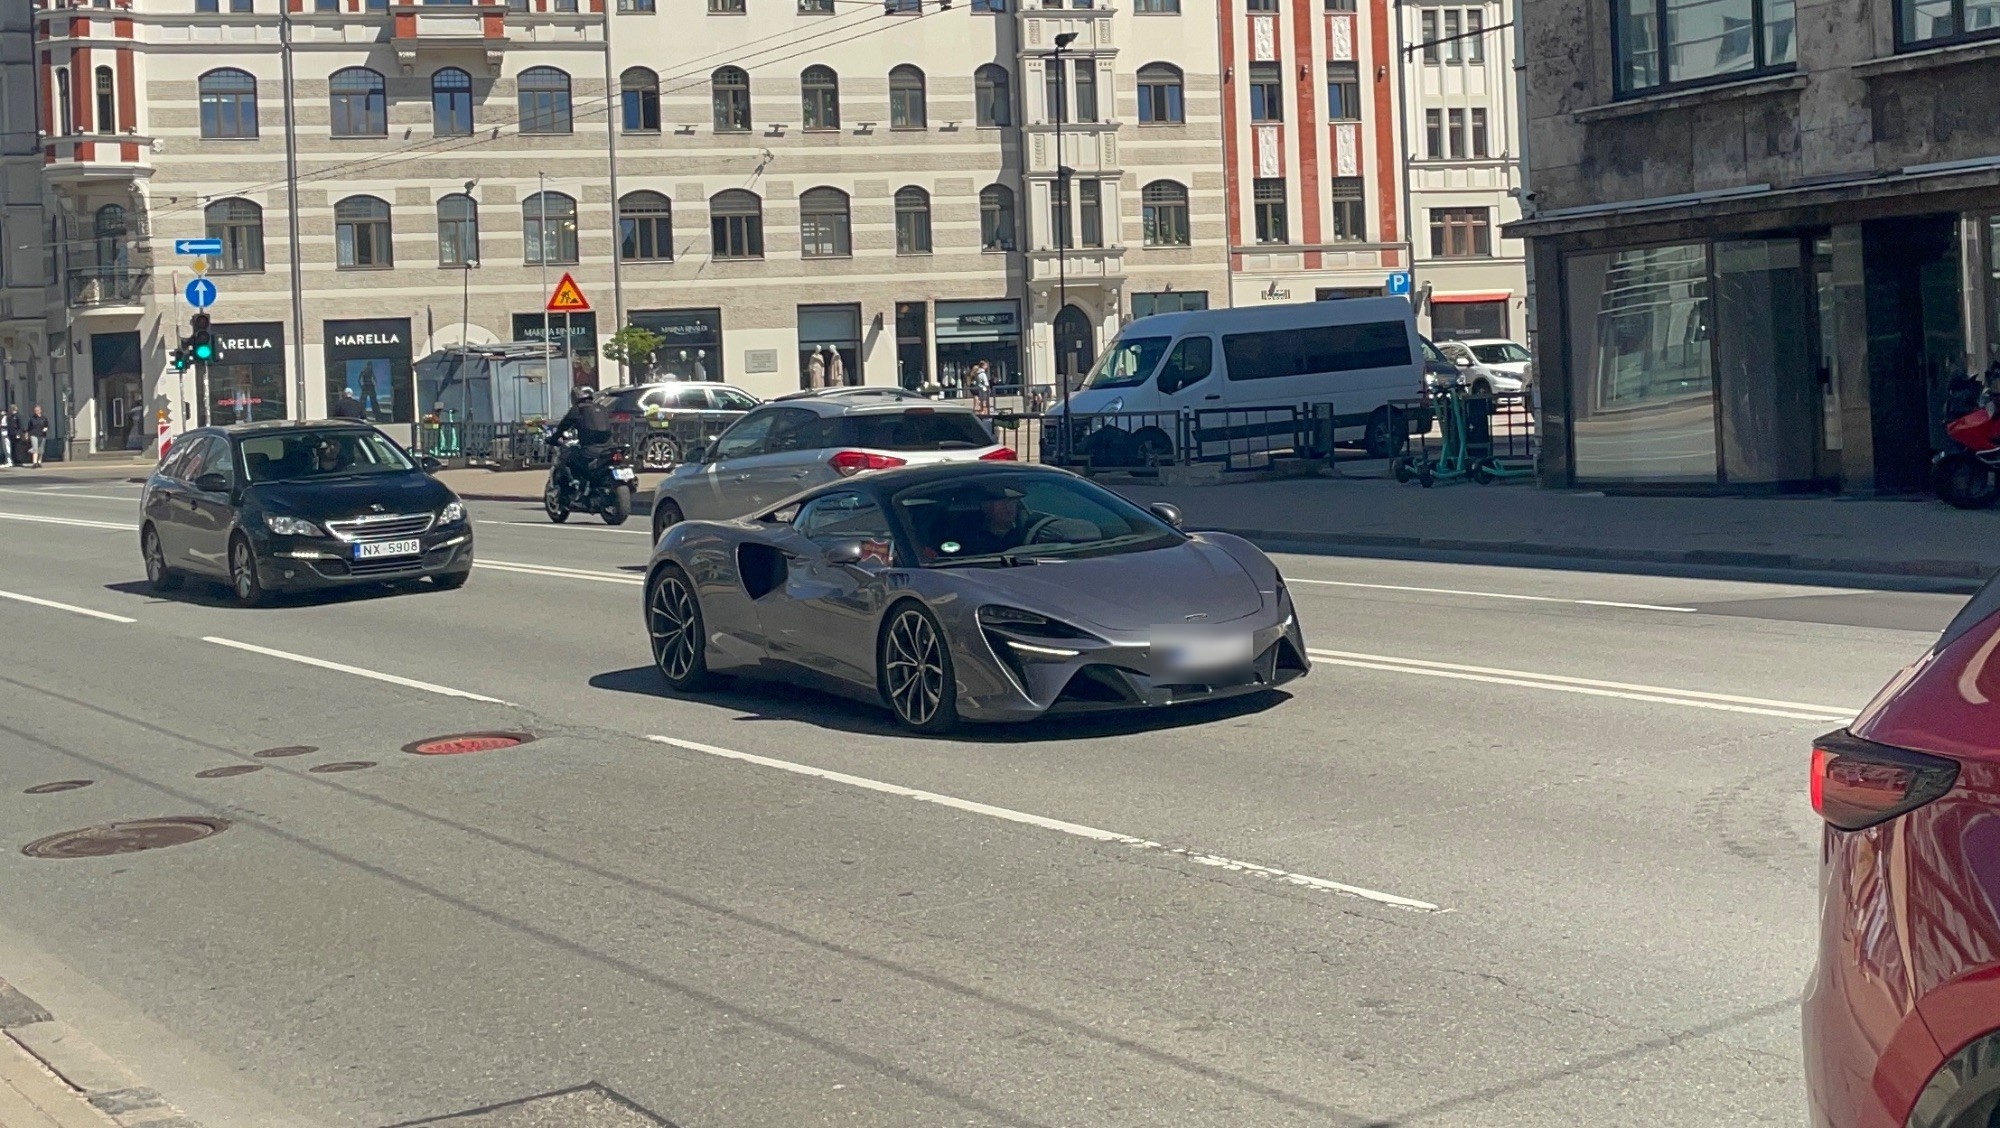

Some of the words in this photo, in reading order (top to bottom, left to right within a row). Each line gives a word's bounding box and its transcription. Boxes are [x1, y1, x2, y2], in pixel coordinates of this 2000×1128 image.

[1393, 274, 1405, 292] P
[218, 337, 272, 350] RELLA
[335, 333, 400, 346] MARELLA
